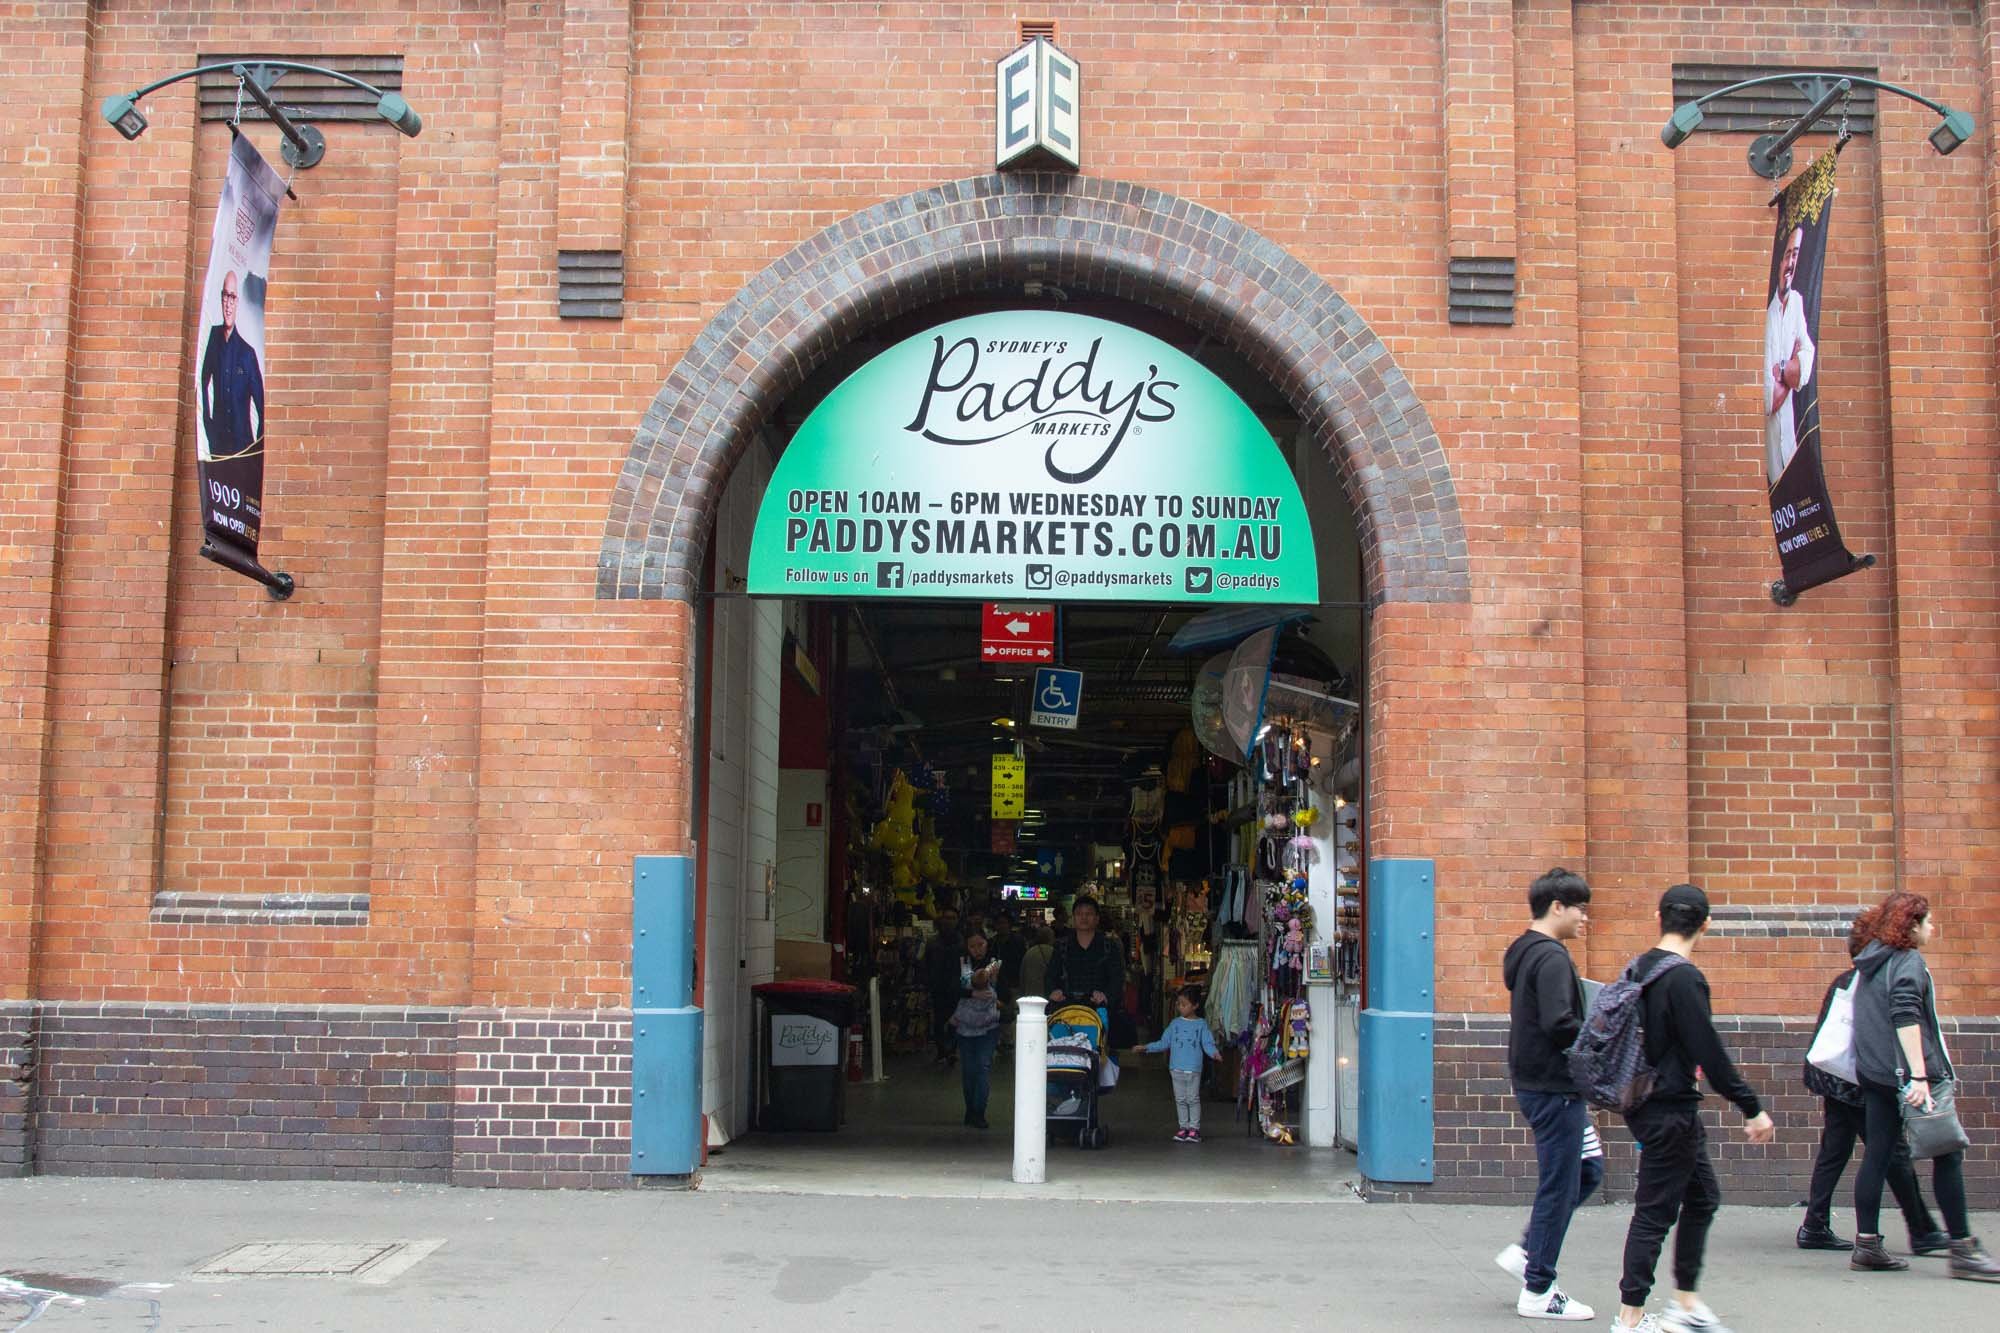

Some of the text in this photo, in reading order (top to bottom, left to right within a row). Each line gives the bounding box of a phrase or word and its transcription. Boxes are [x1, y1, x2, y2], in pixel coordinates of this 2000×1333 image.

[1005, 54, 1030, 150] E
[1048, 55, 1072, 151] E
[986, 340, 1069, 354] SYDNEY'S
[903, 335, 1181, 485] Paddy's
[1030, 422, 1112, 436] MARKETS
[208, 478, 241, 511] 1909
[788, 489, 849, 514] OPEN
[858, 490, 921, 514] 10AM
[950, 491, 1000, 515] 6PM
[1009, 492, 1148, 517] WEDNESDAY
[1154, 495, 1183, 518] TO
[1191, 496, 1281, 520] SUNDAY
[213, 509, 229, 528] NOW
[229, 517, 246, 536] OPEN
[1772, 503, 1796, 534] 1909
[786, 518, 1281, 561] PADDYSMARKETS.COM.AU
[1779, 523, 1830, 554] NOW OPEN LEVEL 3
[786, 568, 829, 583] Follow
[833, 571, 849, 583] us
[853, 571, 869, 583] on
[907, 569, 1014, 588] /paddysmarkets
[1055, 570, 1173, 588] @paddysmarkets
[1216, 572, 1280, 590] @paddys
[998, 647, 1034, 656] OFFICE
[1037, 713, 1071, 727] ENTRY
